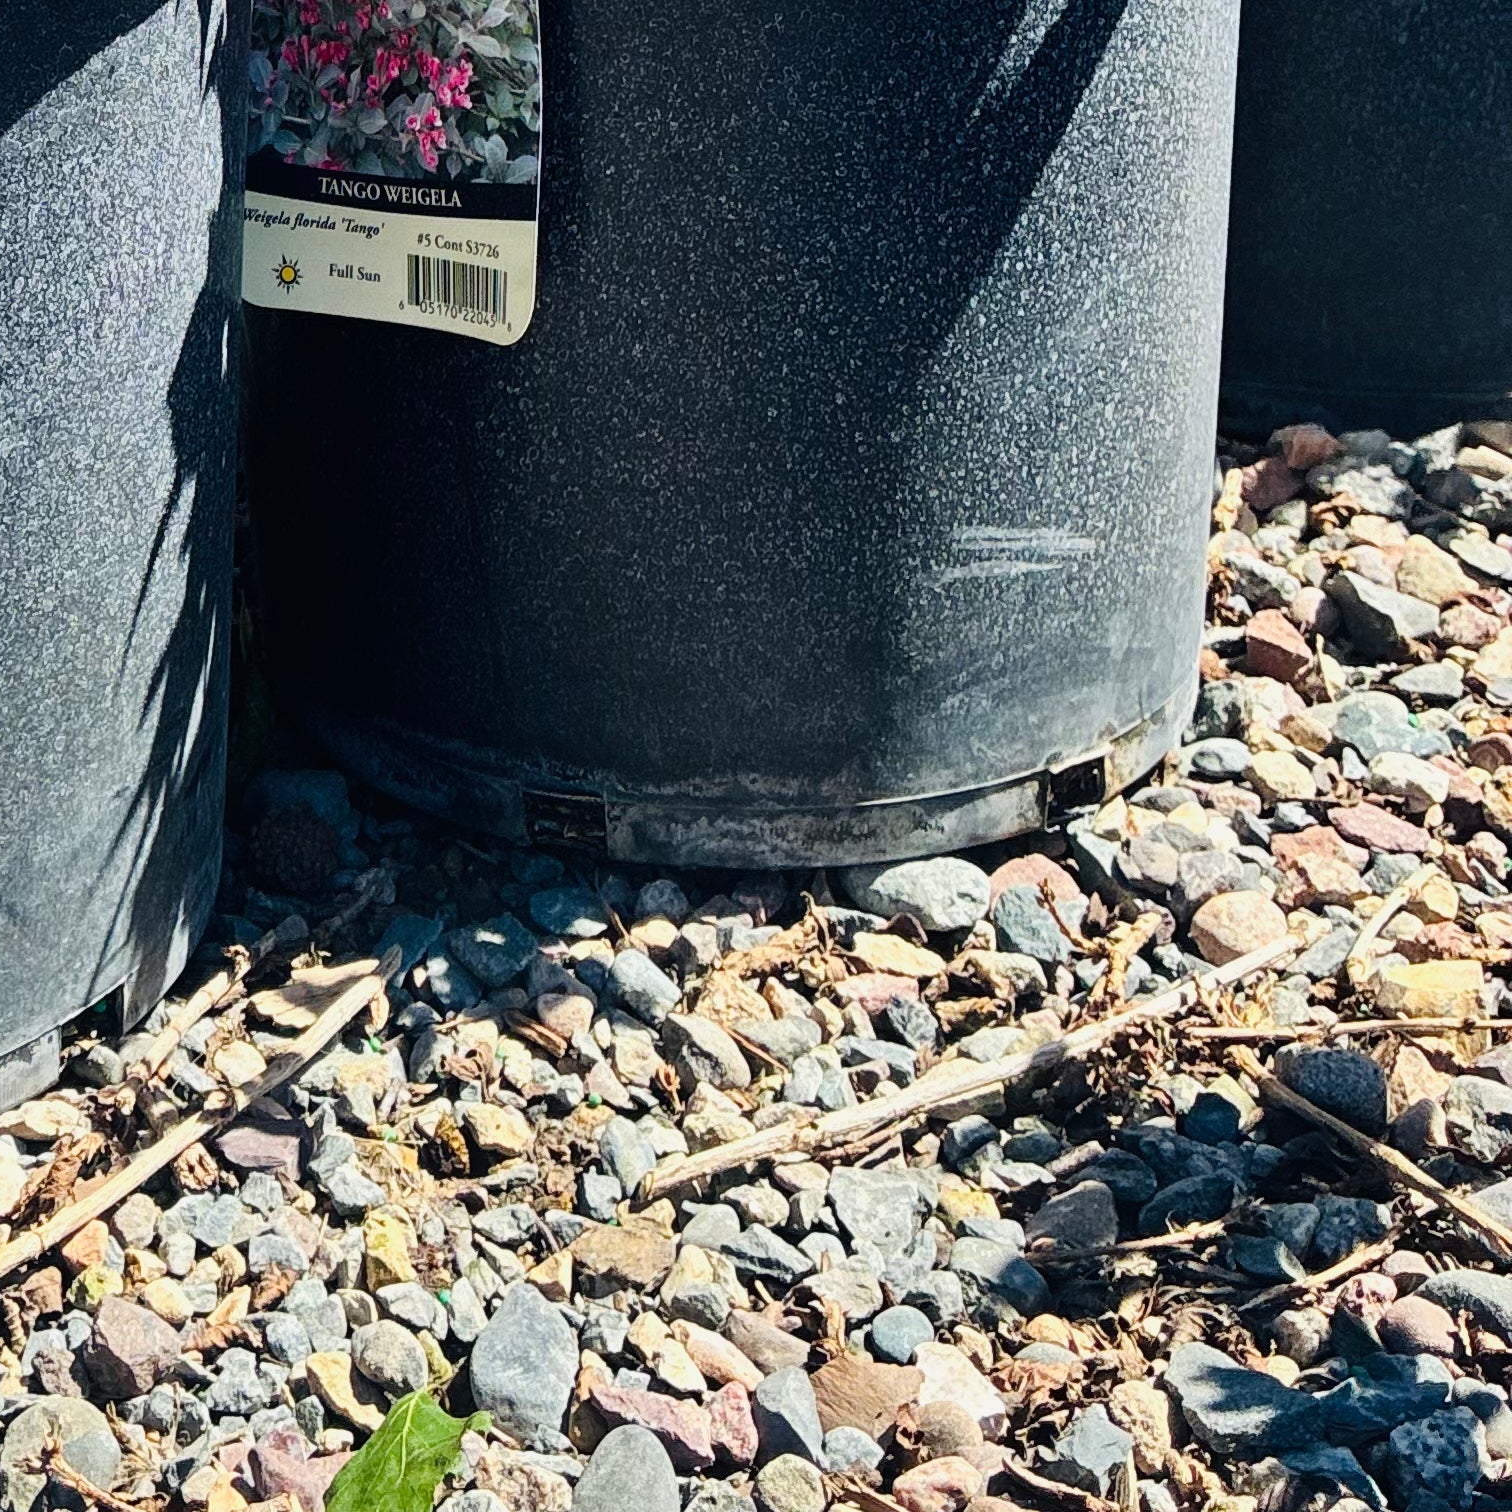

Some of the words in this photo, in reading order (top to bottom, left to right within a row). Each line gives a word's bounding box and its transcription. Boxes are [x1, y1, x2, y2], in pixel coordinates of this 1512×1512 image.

[318, 176, 380, 201] TANGO
[384, 185, 462, 207] WEIGELA
[243, 208, 290, 228] Weigela
[291, 215, 336, 231] florida
[341, 219, 385, 240] 'Tango'
[417, 234, 431, 248] #5
[435, 235, 463, 252] Cont
[465, 243, 500, 259] S3726
[328, 263, 354, 279] Full
[357, 268, 381, 283] Sun
